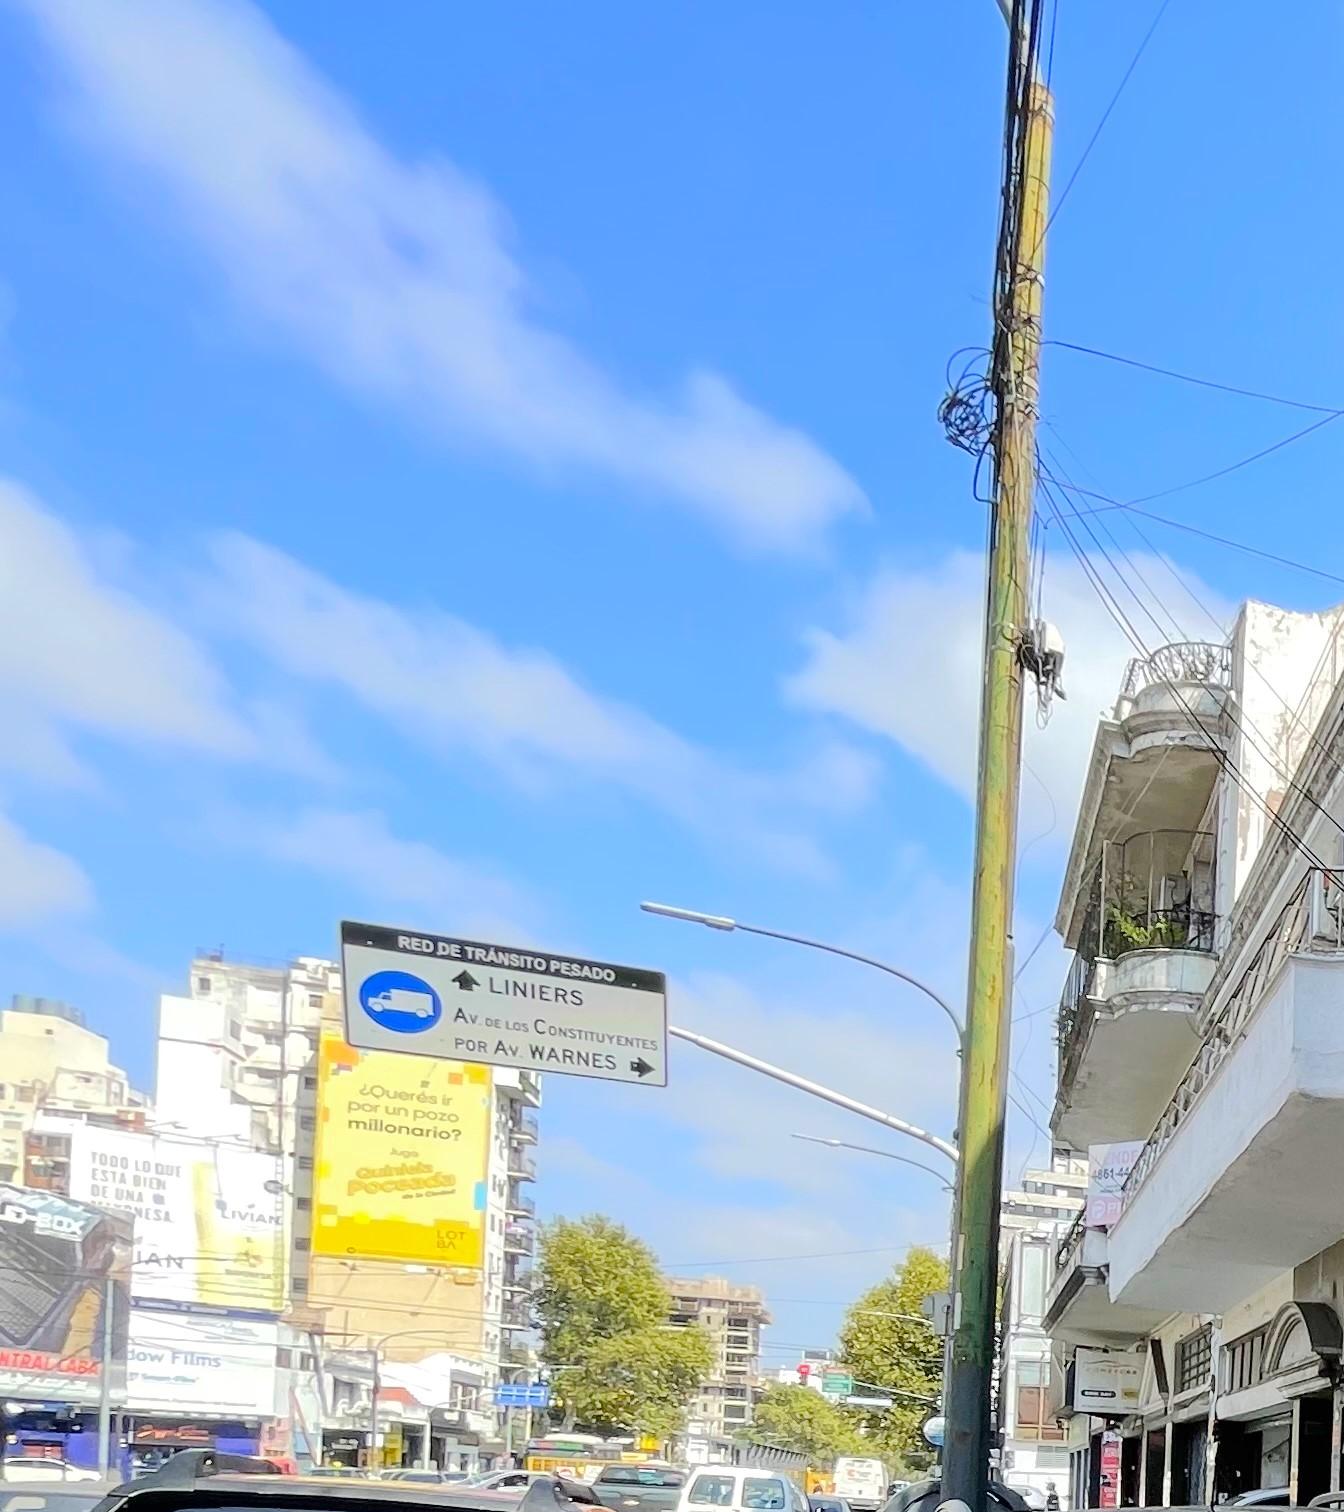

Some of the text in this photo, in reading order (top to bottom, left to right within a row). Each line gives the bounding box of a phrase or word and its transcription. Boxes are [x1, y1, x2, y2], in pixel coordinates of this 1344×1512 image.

[397, 935, 617, 983] RED DE TRÁNSITO PESADO
[488, 976, 584, 1007] LINIERS
[454, 1037, 488, 1055] POR
[529, 1044, 618, 1072] WARNES
[347, 1100, 460, 1123] por un pozo
[348, 1118, 462, 1141] millonario?
[91, 1152, 181, 1178] TODO LO QUE
[90, 1183, 144, 1203] DE UNA
[171, 1351, 222, 1368] Films
